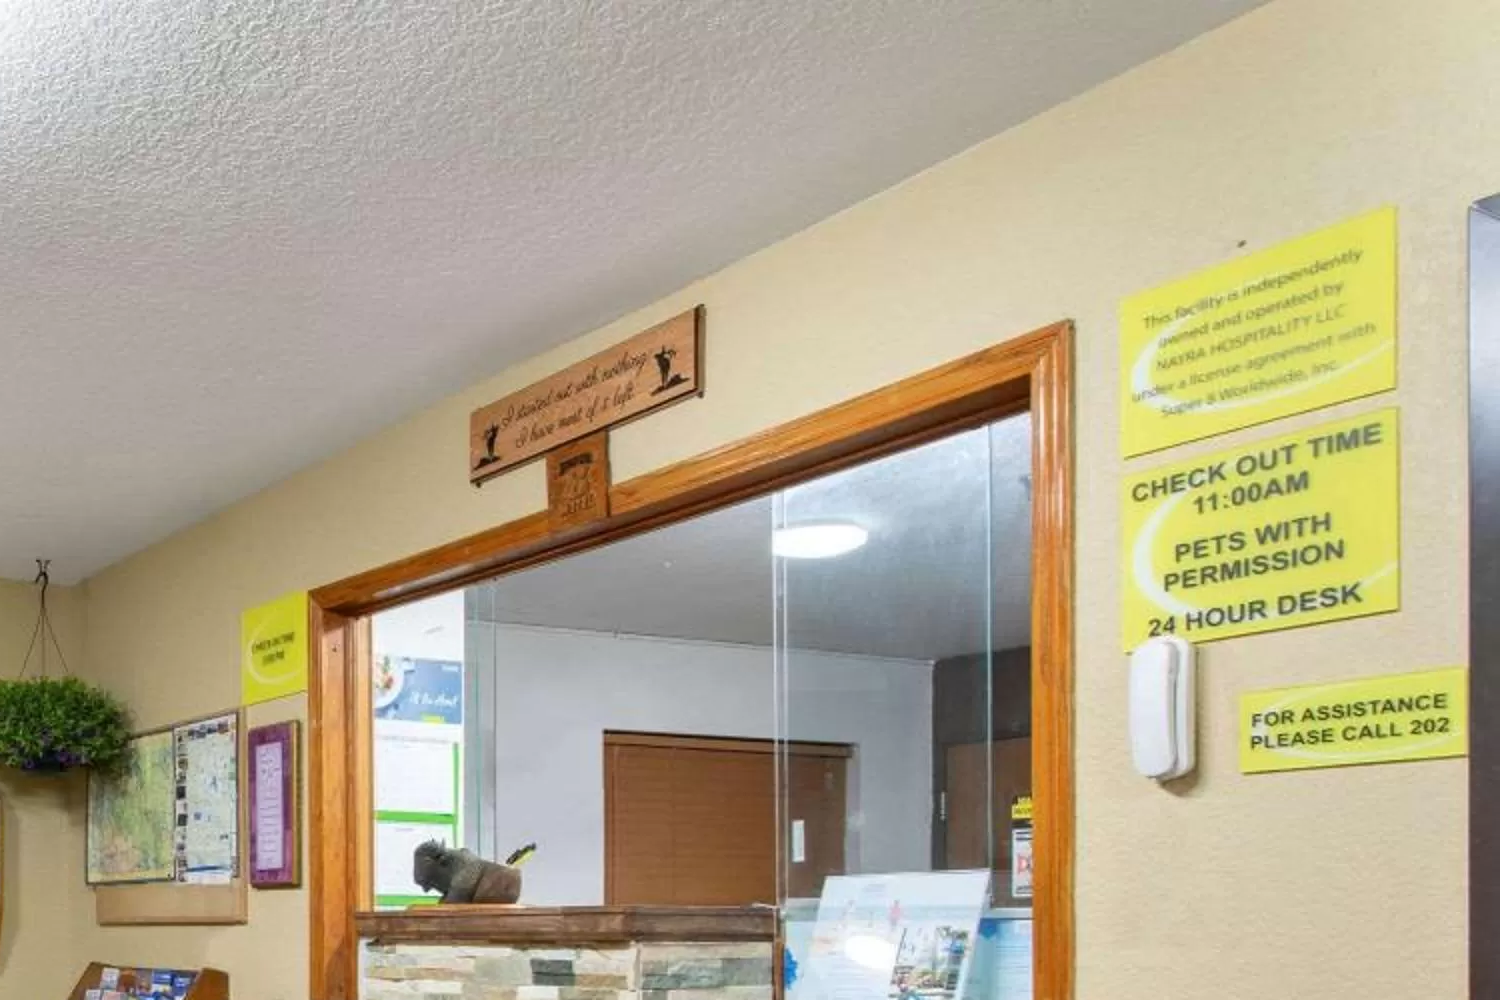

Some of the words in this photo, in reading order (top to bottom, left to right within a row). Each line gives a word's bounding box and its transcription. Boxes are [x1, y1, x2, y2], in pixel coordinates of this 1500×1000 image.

[1143, 313, 1172, 329] This
[1175, 294, 1224, 320] facility
[1227, 289, 1239, 302] is
[1242, 248, 1364, 297] independently
[1158, 323, 1209, 348] owned
[1212, 313, 1241, 331] and
[1246, 288, 1319, 321] operated
[1323, 280, 1345, 301] by
[1210, 314, 1313, 355] HOSPITALITY
[1316, 303, 1347, 323] LLC
[1132, 382, 1174, 401] under
[1177, 378, 1186, 390] a
[1189, 361, 1242, 385] license
[1246, 334, 1333, 373] agreement
[1337, 322, 1376, 341] with
[1131, 461, 1227, 503] CHECK
[1235, 443, 1299, 476] OUT
[1306, 421, 1383, 459] TIME
[1193, 470, 1311, 515] 11:00AM
[1175, 530, 1246, 563] PETS
[1254, 512, 1333, 546] WITH
[1164, 538, 1346, 593] PERMISSION
[1147, 617, 1176, 639] 24
[1186, 598, 1267, 632] HOUR
[1278, 581, 1363, 617] DESK
[1250, 728, 1335, 751] PLEASE
[1342, 722, 1403, 743] CALL
[1410, 716, 1451, 735] 202
[1251, 708, 1295, 729] FOR
[1300, 692, 1448, 723] ASSISTANCE
